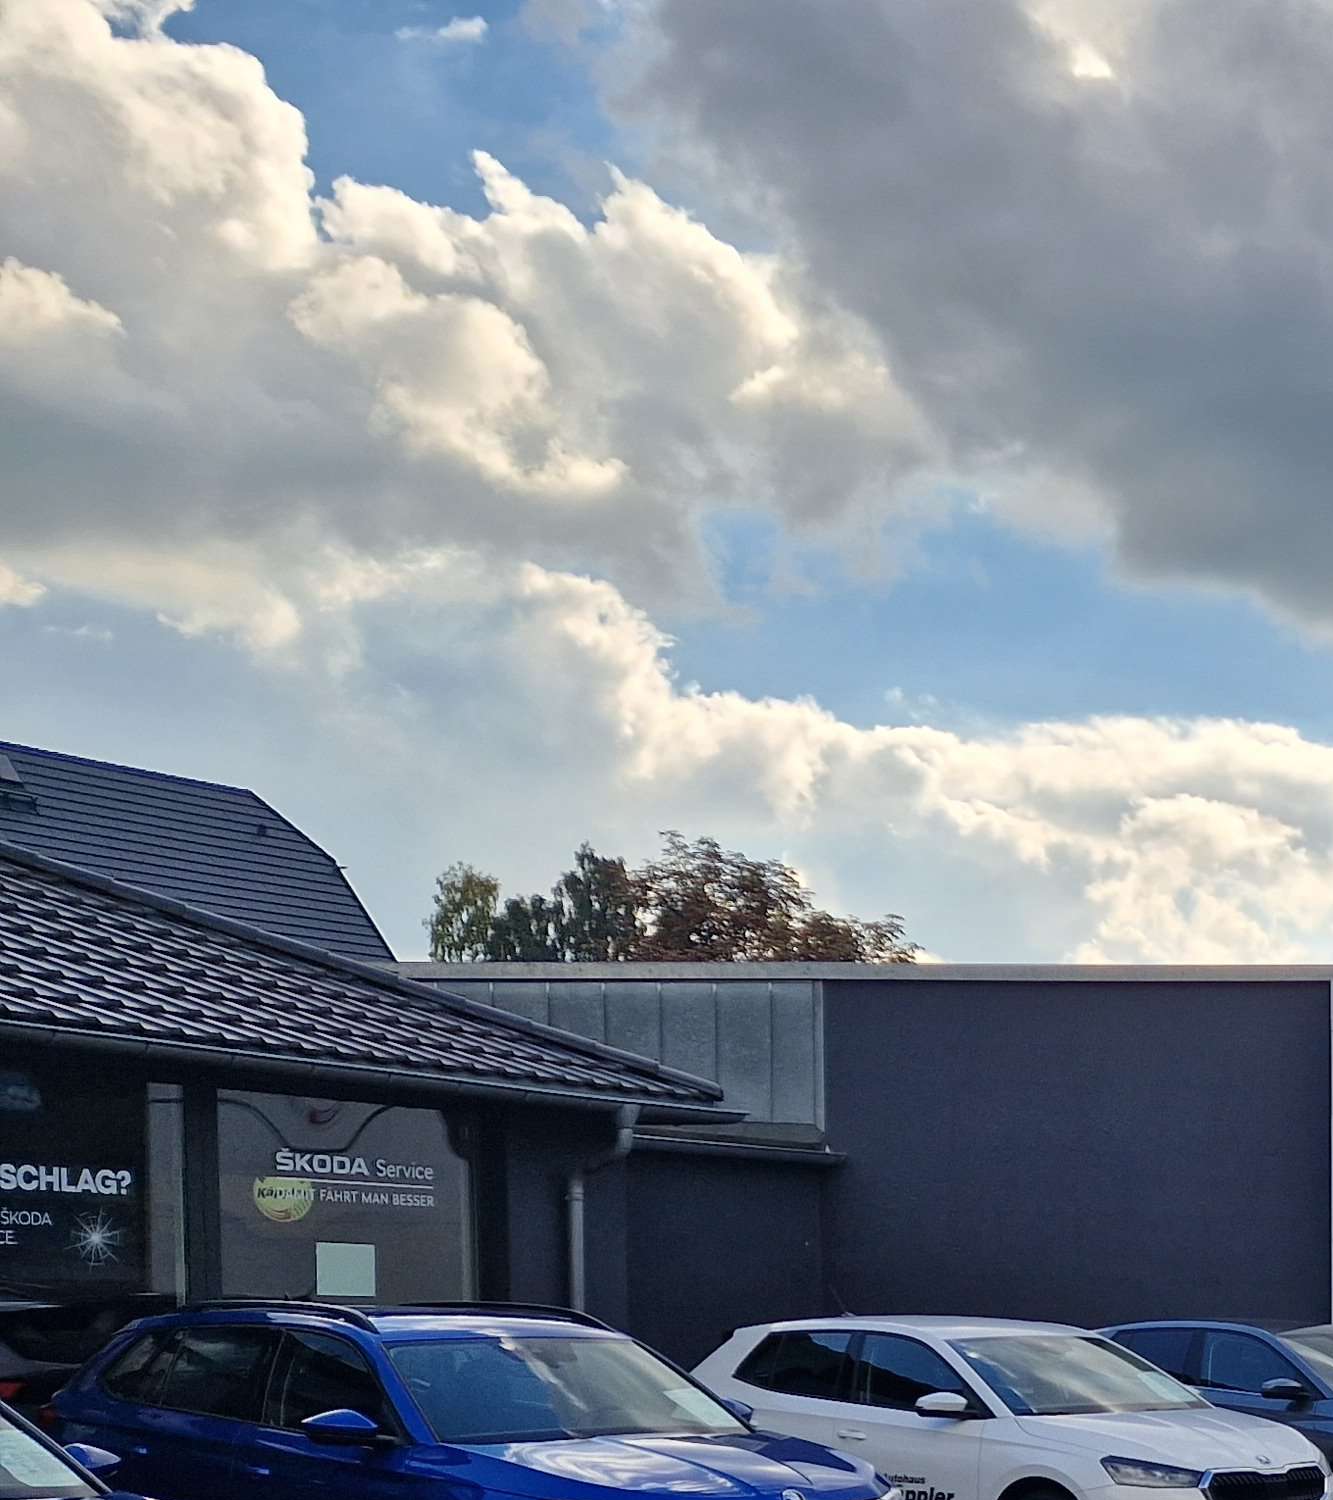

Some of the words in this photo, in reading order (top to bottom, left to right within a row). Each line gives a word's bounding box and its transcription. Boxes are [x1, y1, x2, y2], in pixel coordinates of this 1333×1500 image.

[275, 1147, 369, 1176] ŠKODA
[376, 1159, 433, 1180] Service
[320, 1186, 358, 1203] FÄHRT
[361, 1193, 389, 1205] MAN
[393, 1194, 434, 1207] BESSER
[0, 1207, 53, 1226] ŠKODA
